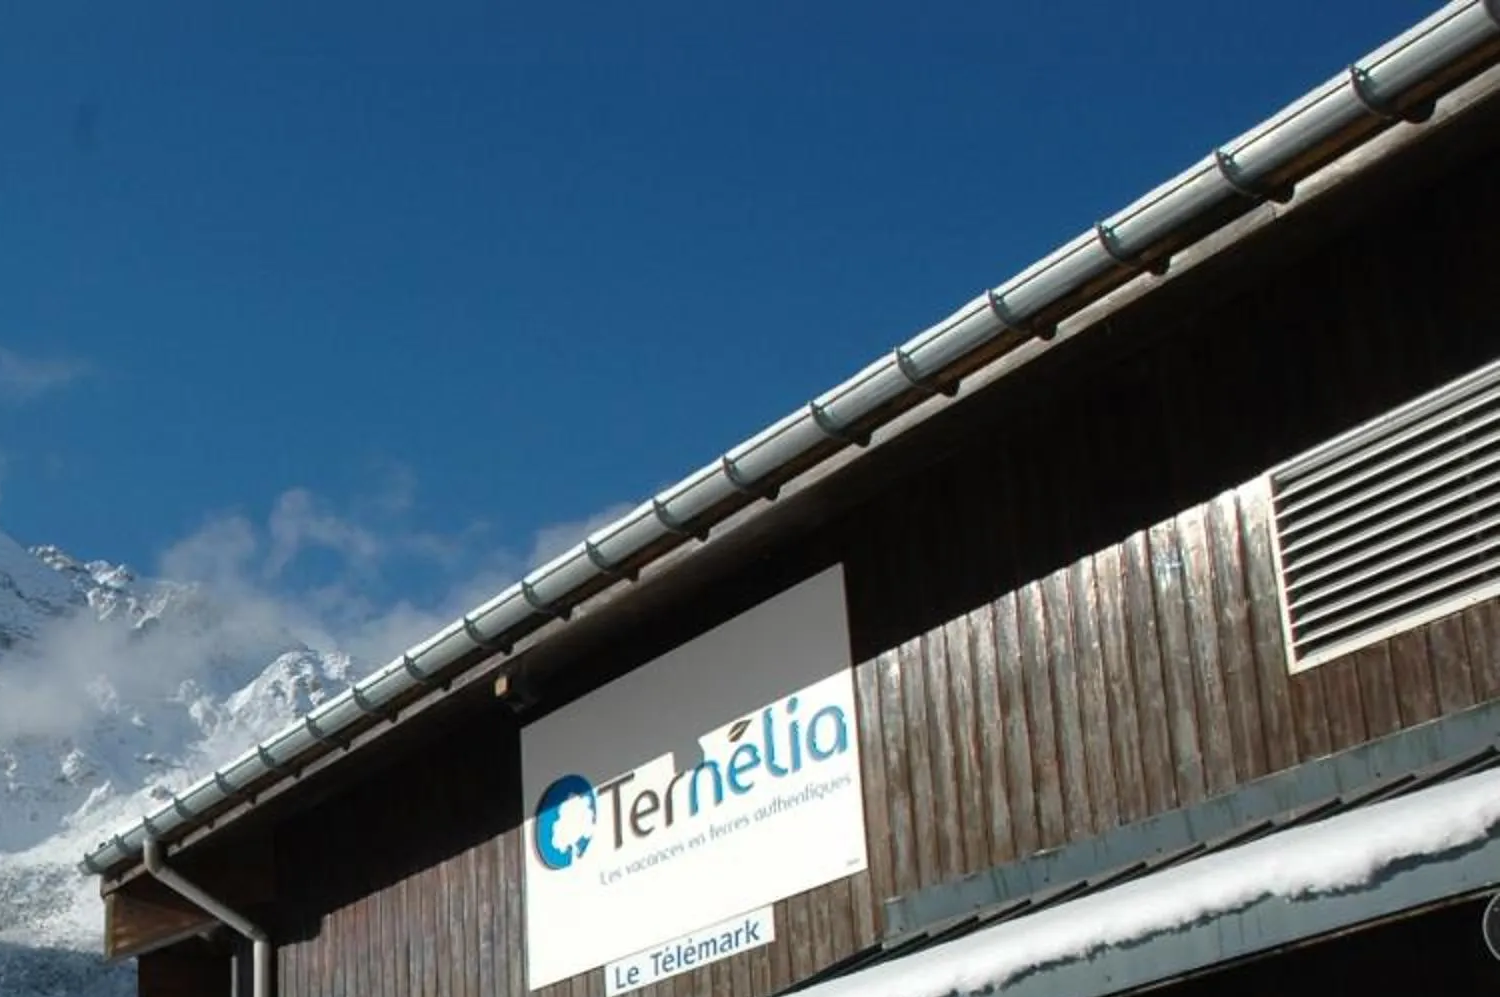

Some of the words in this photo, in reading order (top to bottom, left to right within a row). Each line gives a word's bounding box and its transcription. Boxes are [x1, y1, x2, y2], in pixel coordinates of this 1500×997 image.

[597, 697, 849, 851] Ternélia
[599, 868, 623, 886] Les
[625, 841, 685, 875] vacances
[688, 833, 707, 849] en
[709, 815, 751, 842] terres
[754, 776, 852, 823] authentiques
[615, 965, 640, 989] Le
[650, 919, 761, 977] Télémark
